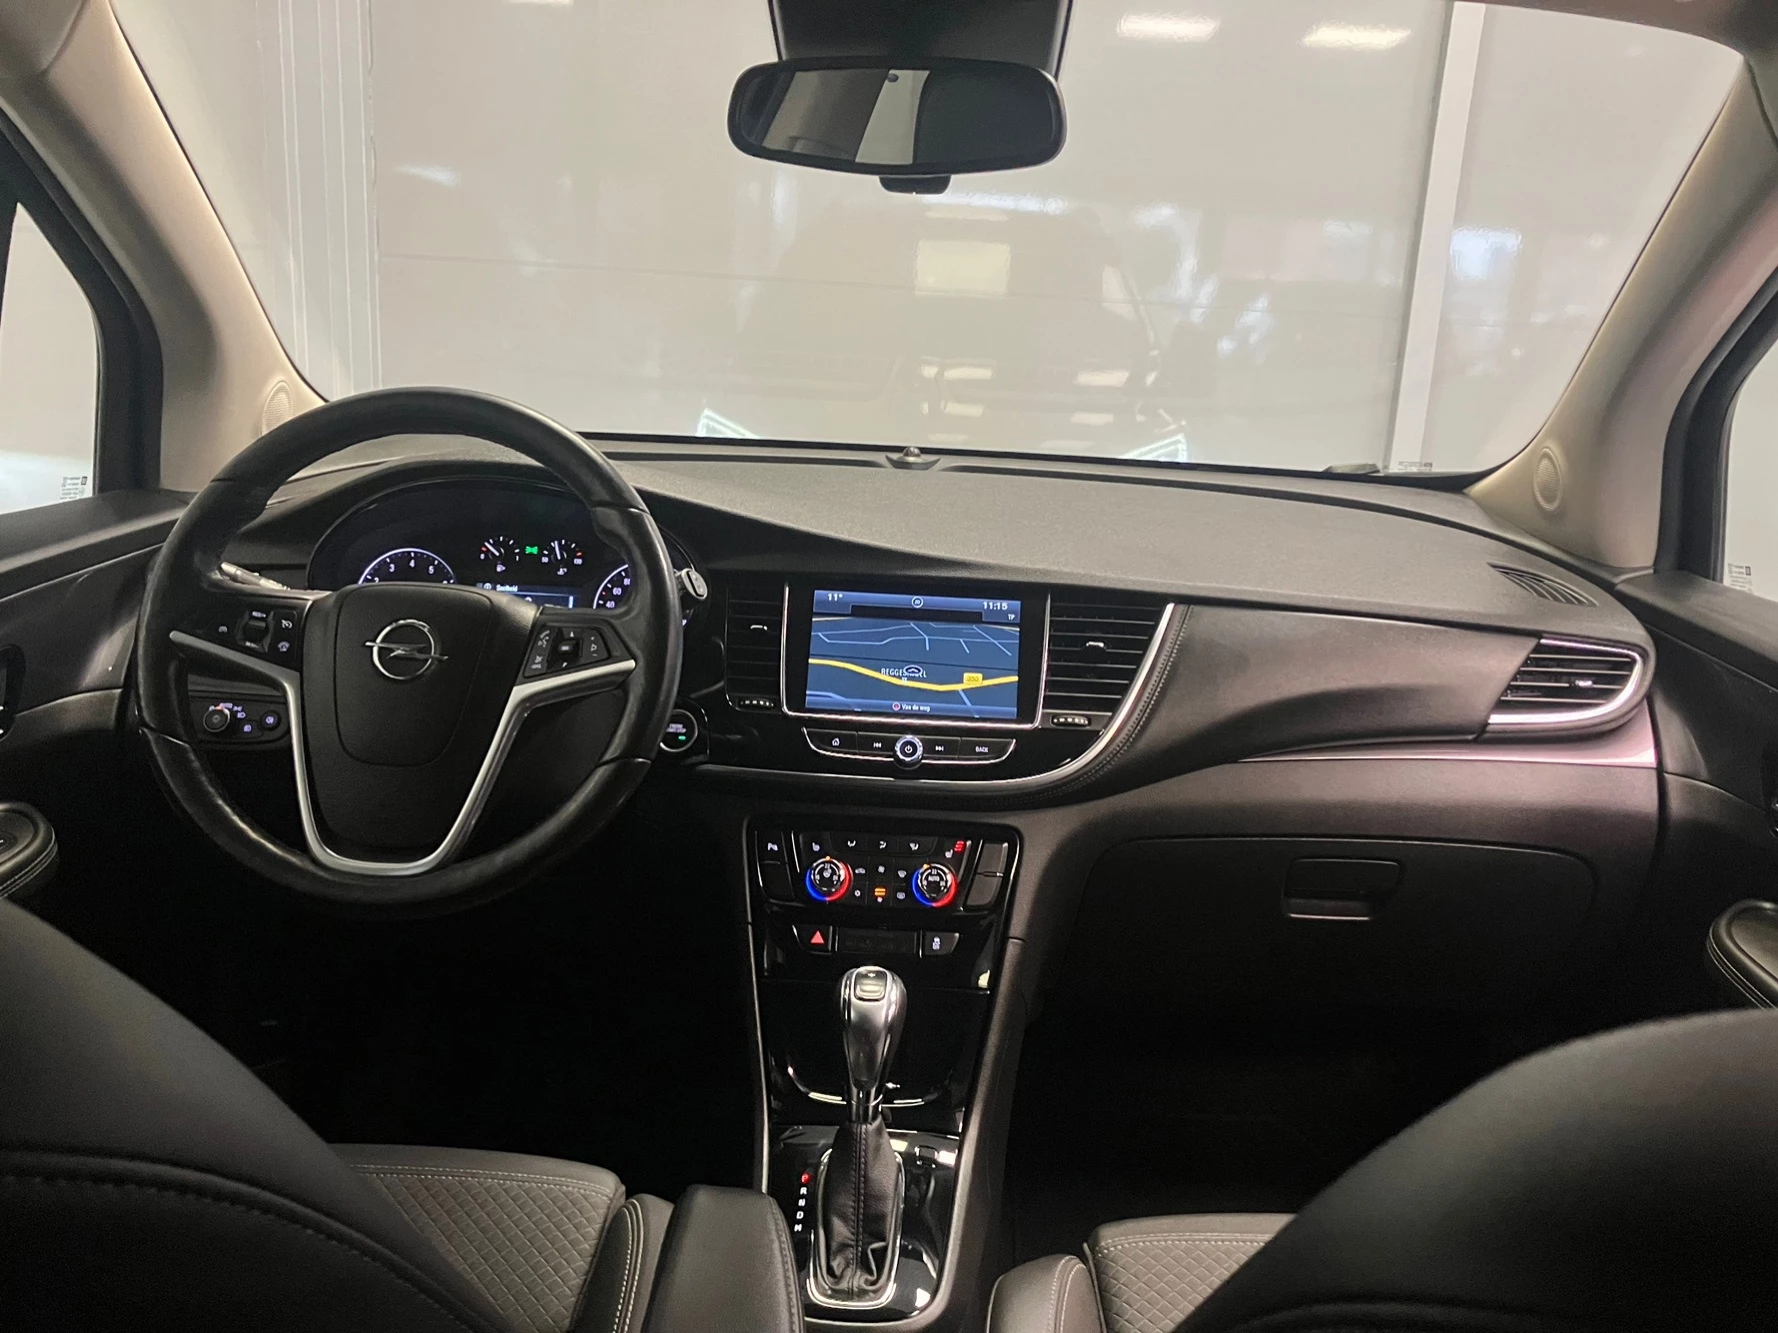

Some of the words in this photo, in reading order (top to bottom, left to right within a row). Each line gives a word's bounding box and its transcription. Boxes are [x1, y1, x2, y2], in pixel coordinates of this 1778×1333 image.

[389, 563, 395, 573] 3
[409, 559, 415, 568] 4
[428, 565, 434, 574] 5
[612, 587, 622, 595] 60
[983, 601, 1008, 611] 11:15
[901, 703, 912, 711] Van
[800, 1187, 807, 1195] R
[798, 1199, 806, 1207] N
[796, 1211, 804, 1220] D
